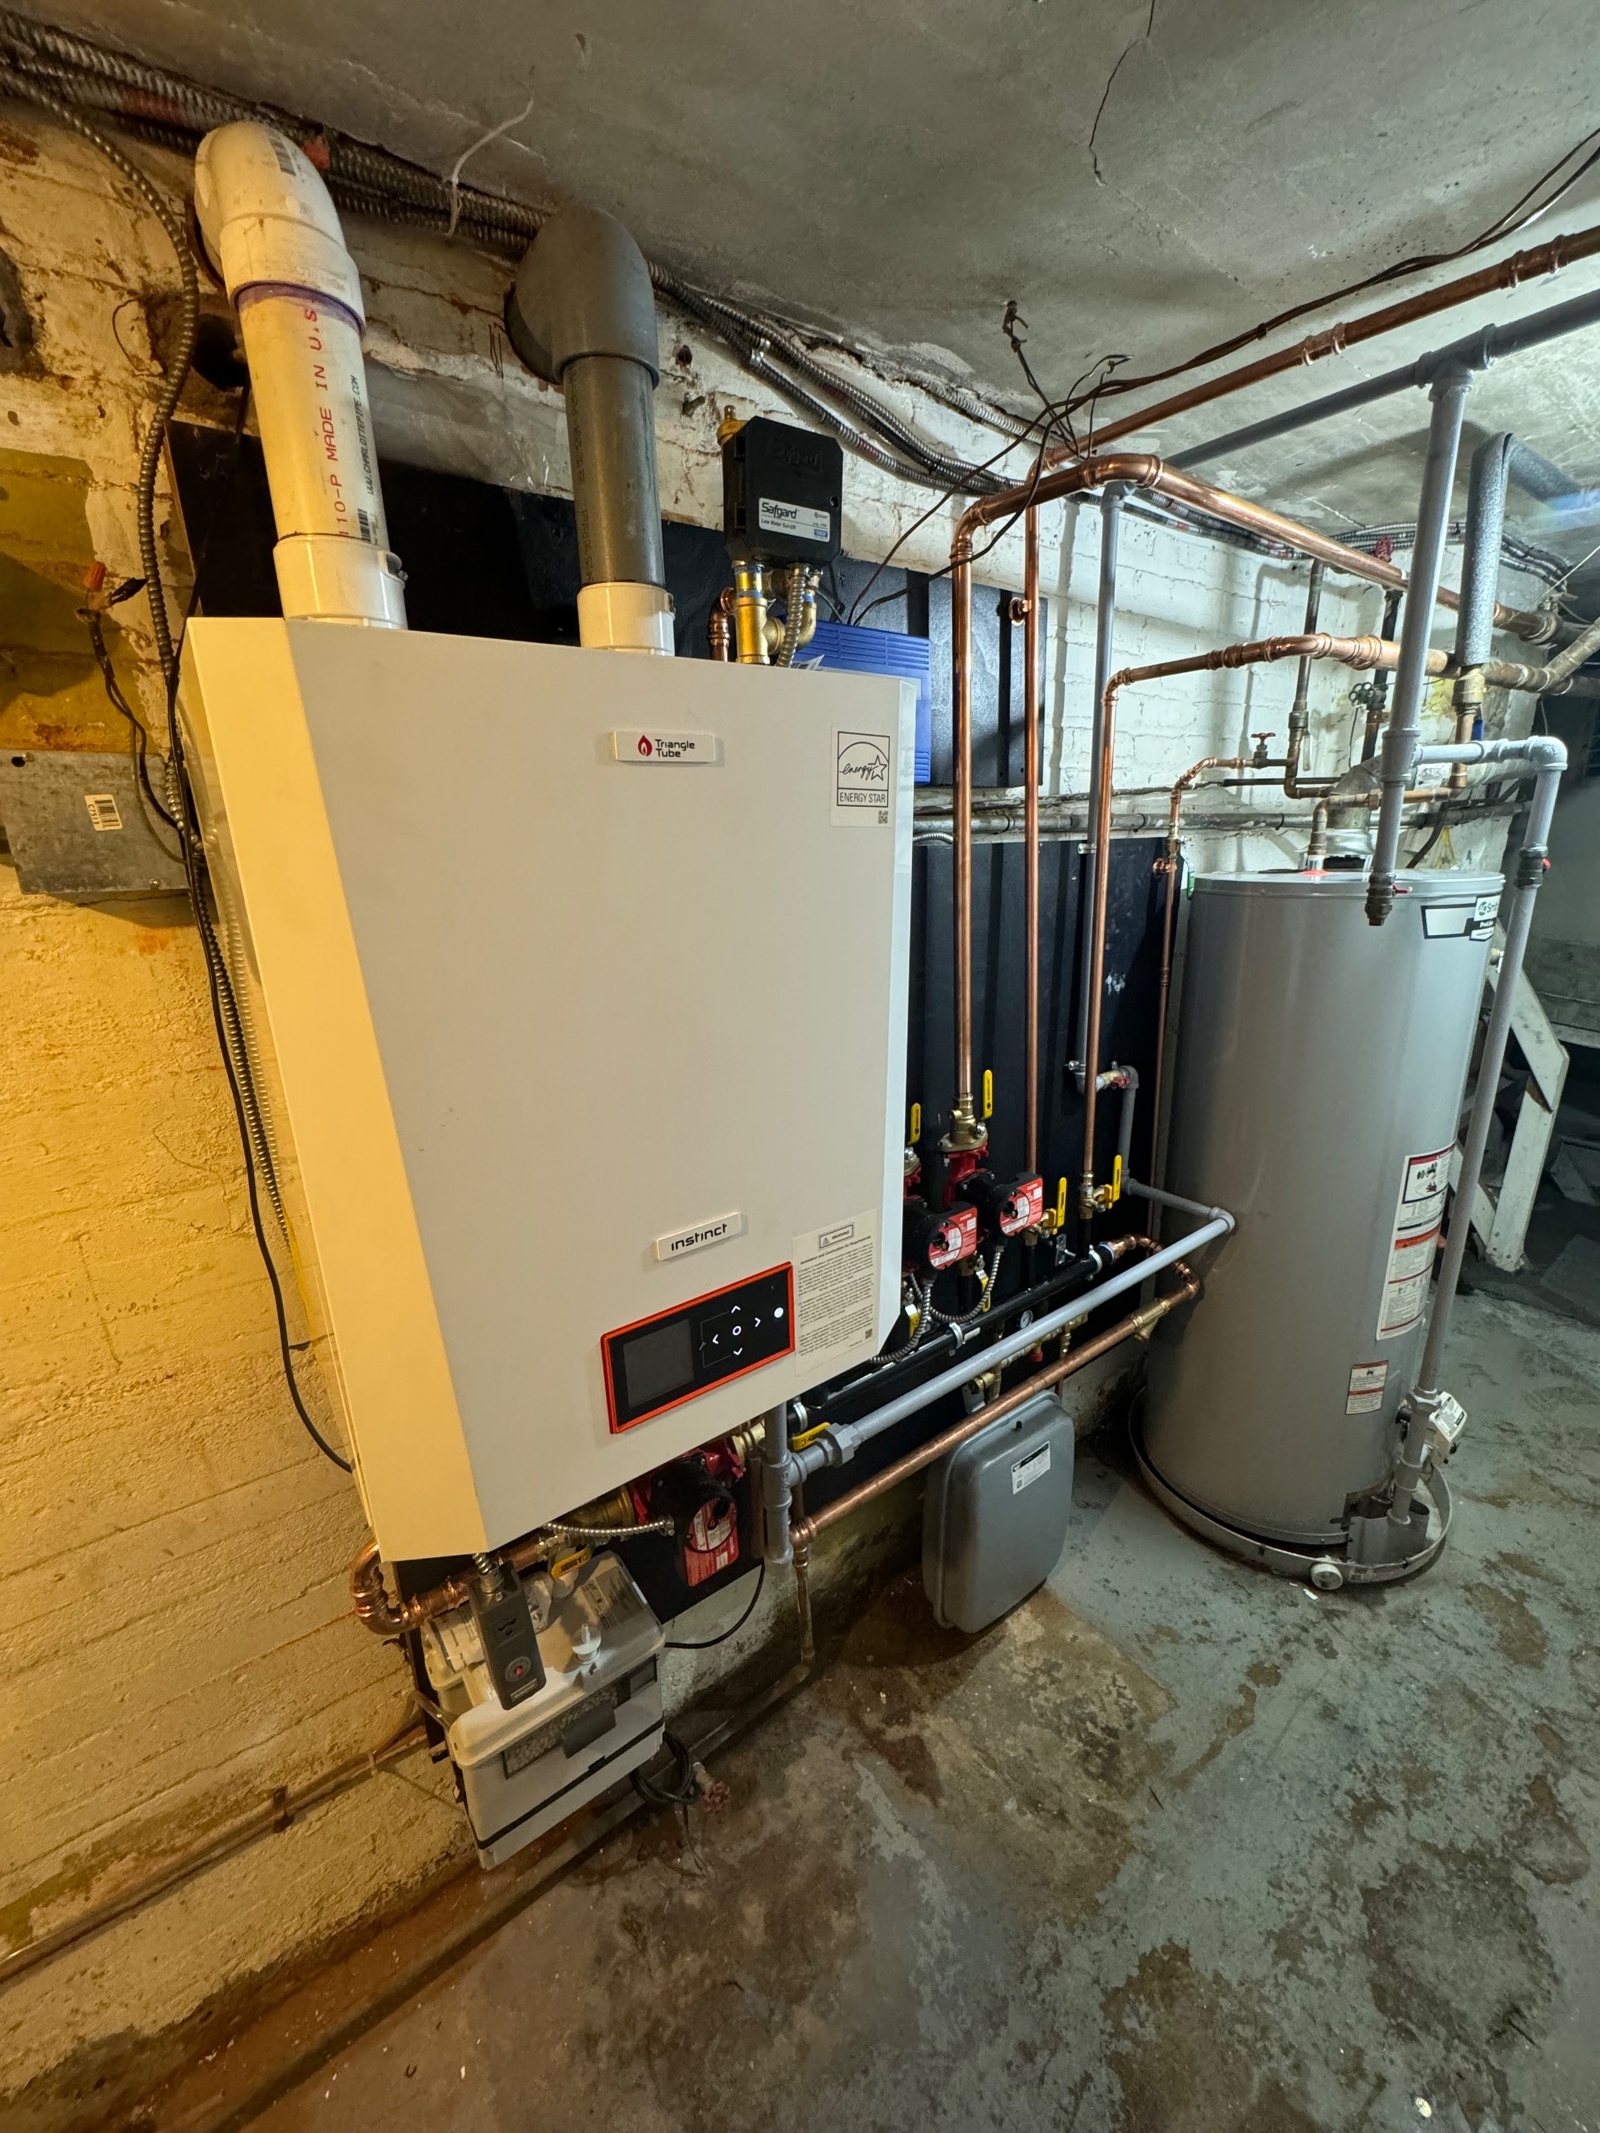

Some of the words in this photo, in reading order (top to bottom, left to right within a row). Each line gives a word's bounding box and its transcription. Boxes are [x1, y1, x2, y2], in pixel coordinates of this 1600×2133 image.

[313, 365, 328, 391] IN
[319, 406, 339, 462] MADE
[761, 502, 798, 519] Safgard
[654, 739, 695, 752] Triangle
[655, 748, 682, 758] Tube
[840, 762, 873, 781] energy
[839, 791, 868, 803] ENERGY
[868, 793, 887, 804] STAR
[670, 1223, 728, 1251] instinct
